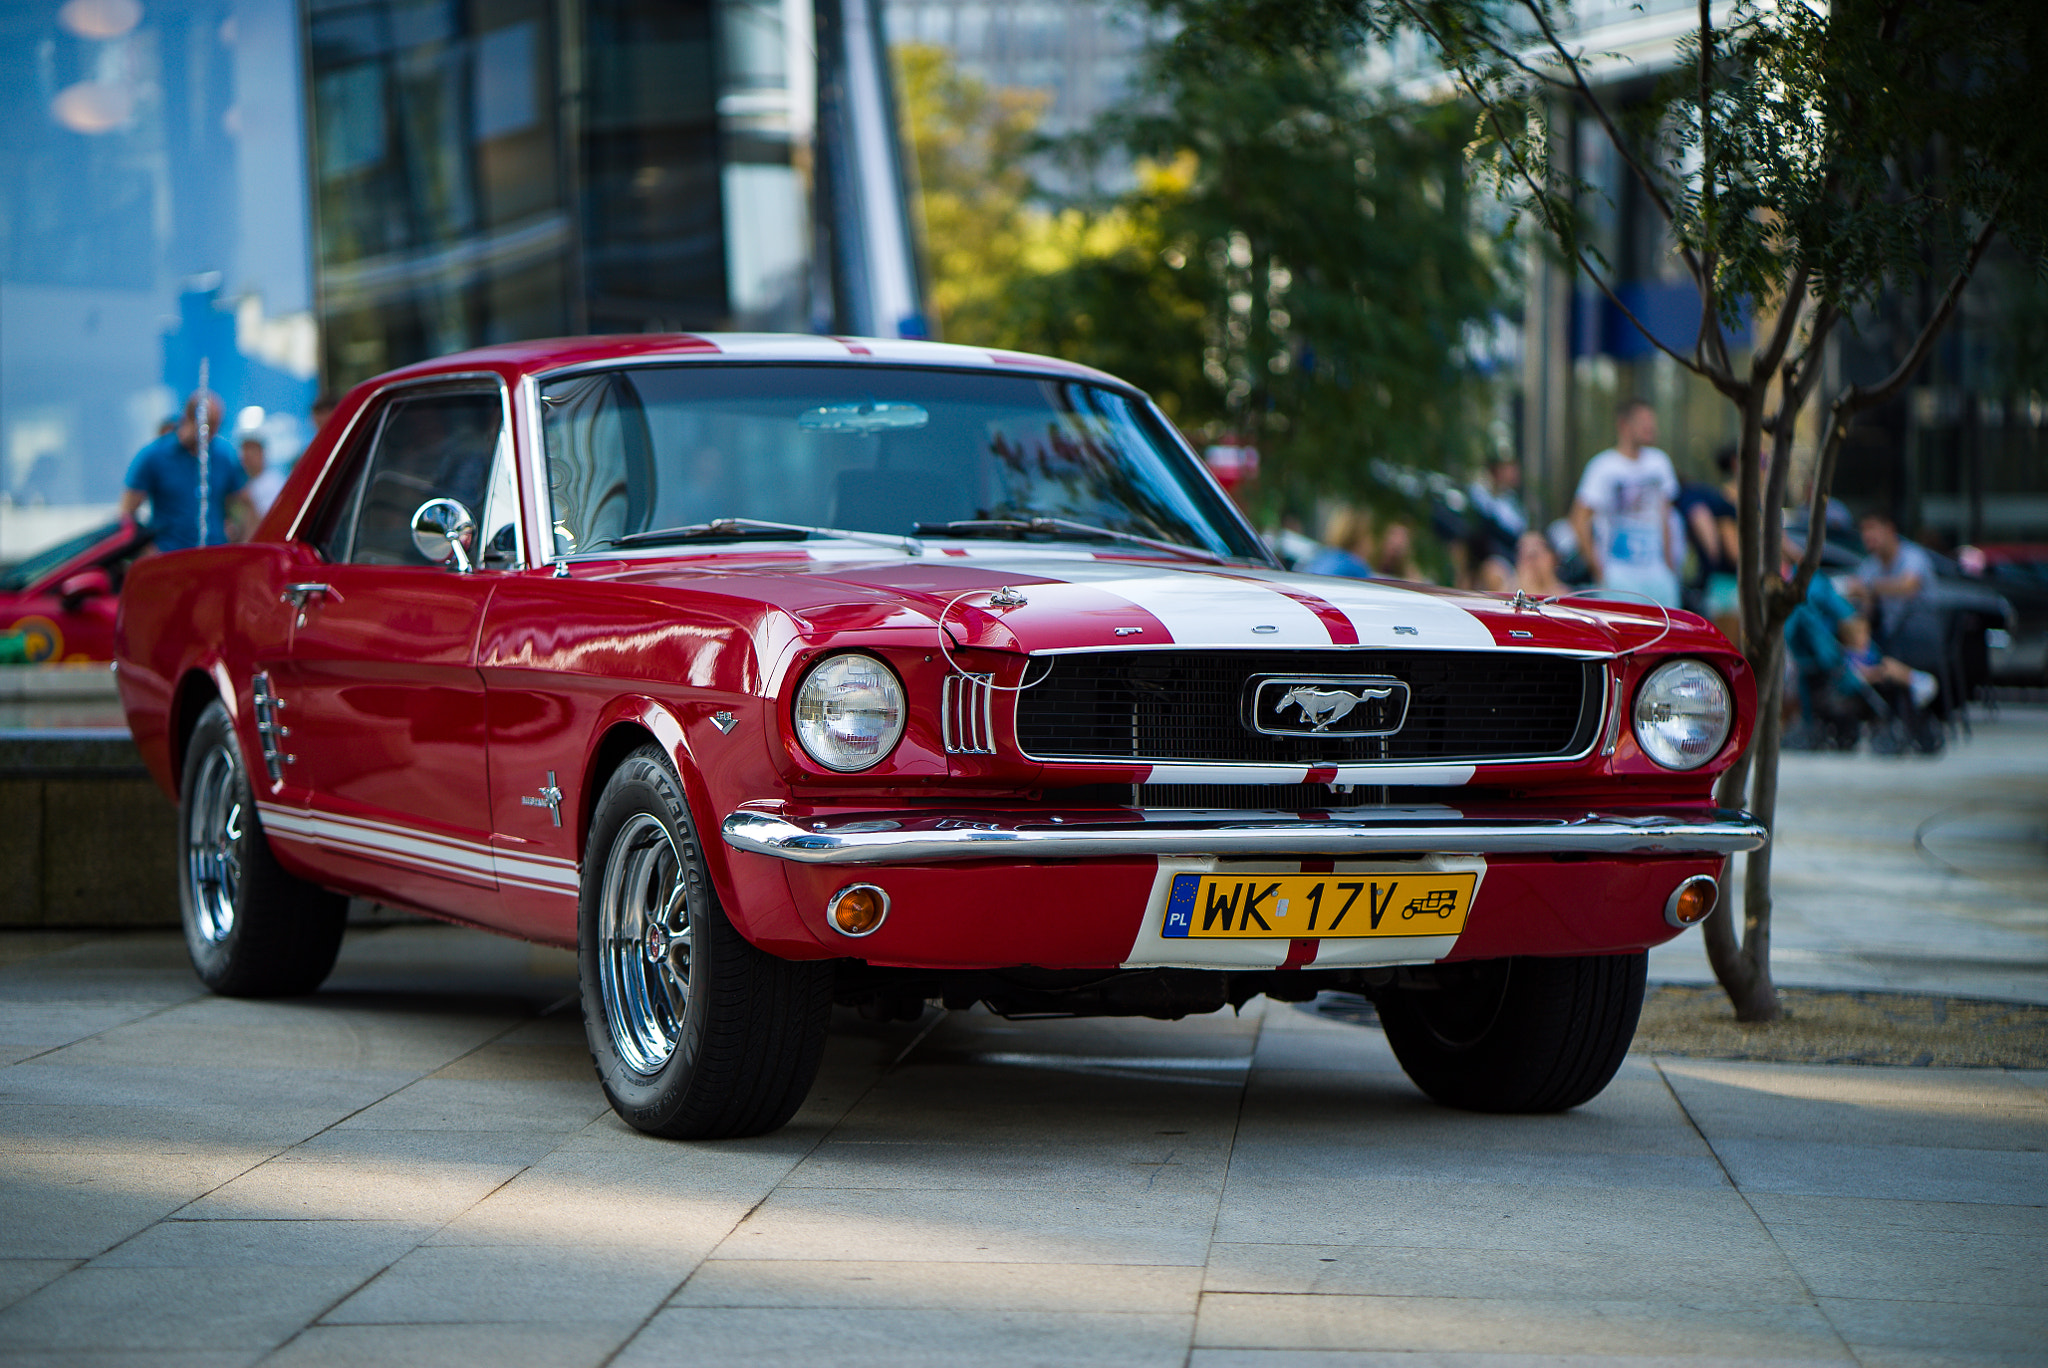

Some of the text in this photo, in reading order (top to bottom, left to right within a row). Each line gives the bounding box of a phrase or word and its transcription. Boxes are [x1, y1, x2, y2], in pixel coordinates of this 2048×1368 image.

[654, 774, 698, 863] TZ300
[1169, 913, 1187, 926] PL
[1202, 882, 1399, 931] WK 17V
